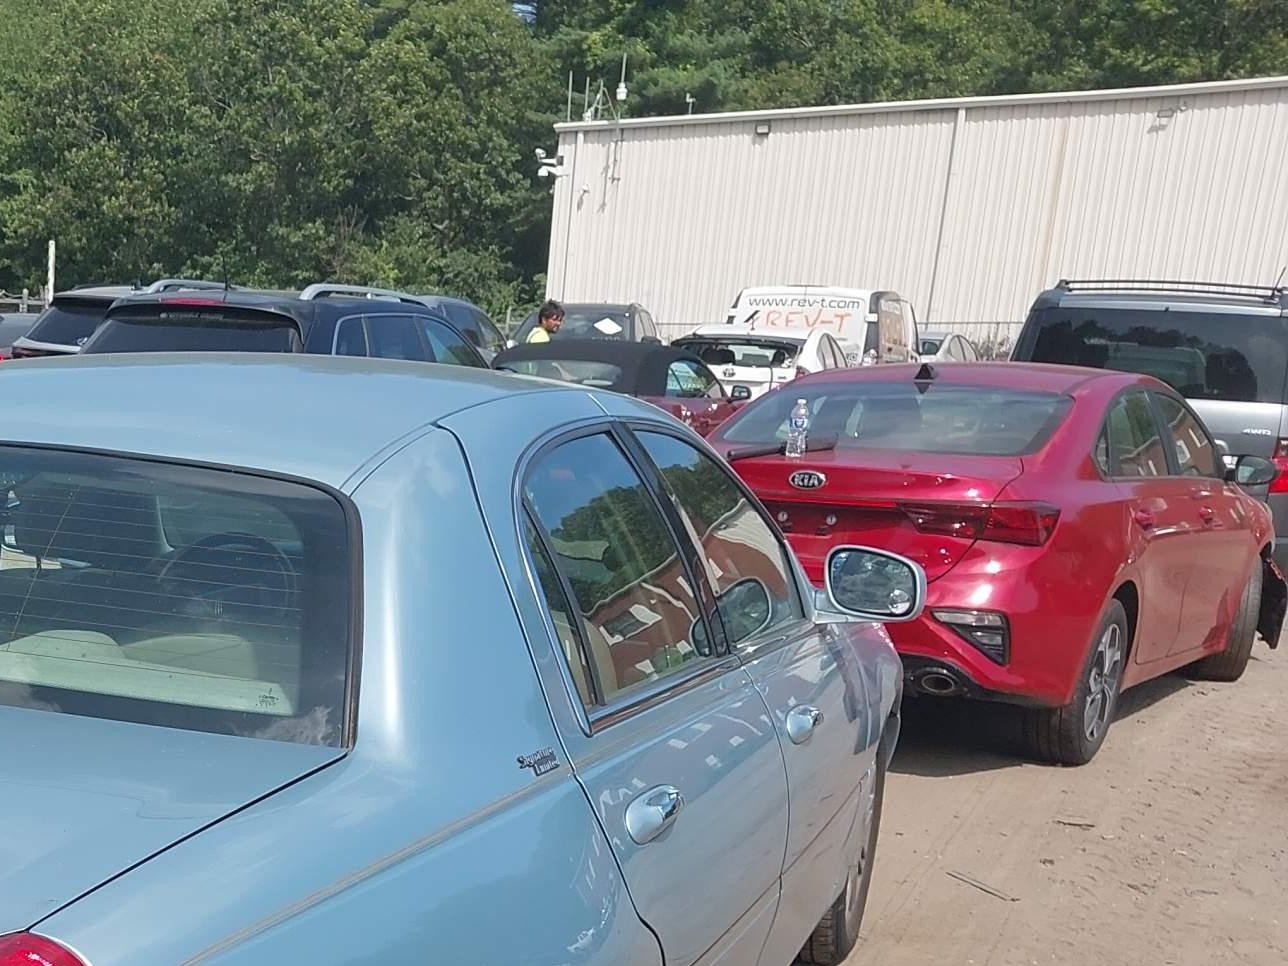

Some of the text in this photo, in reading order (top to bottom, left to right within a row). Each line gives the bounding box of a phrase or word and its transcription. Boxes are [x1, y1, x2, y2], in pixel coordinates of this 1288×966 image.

[748, 297, 860, 310] www.rev-t.com
[765, 309, 853, 333] REV-T
[794, 473, 819, 487] KIA
